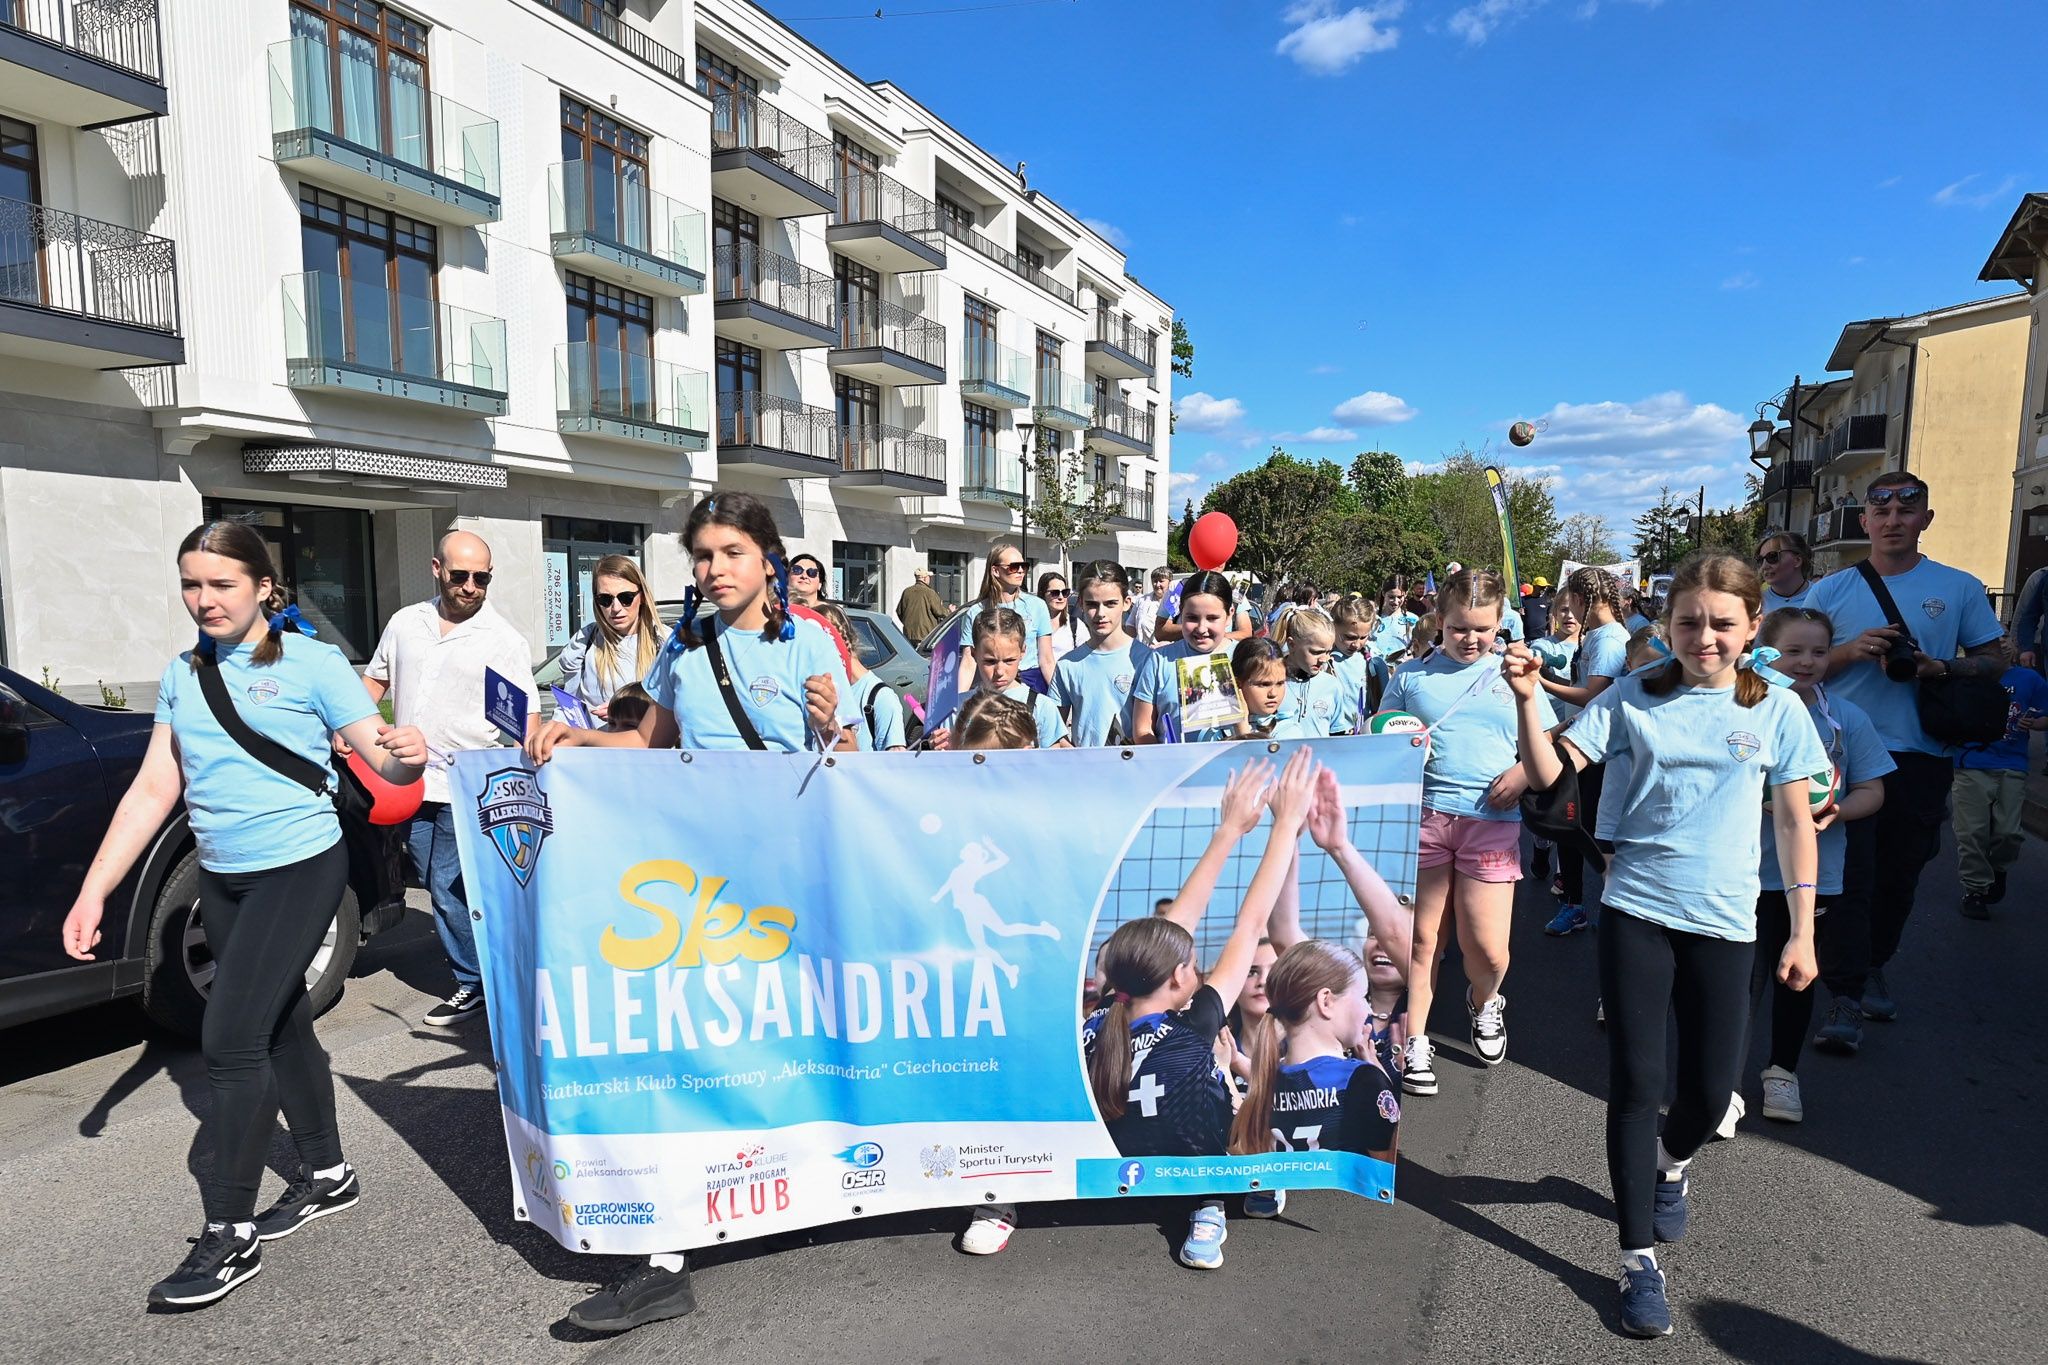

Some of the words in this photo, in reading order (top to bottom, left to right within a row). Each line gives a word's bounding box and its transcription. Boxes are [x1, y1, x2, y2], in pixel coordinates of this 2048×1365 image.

[547, 585, 553, 597] DO
[555, 612, 563, 632] 806
[502, 780, 526, 797] SKS
[535, 954, 1007, 1059] ALEKSANDRIA
[636, 1074, 676, 1093] Klub
[682, 1069, 767, 1093] Sportowy
[893, 1058, 1000, 1076] Ciechocinek
[1272, 1087, 1340, 1112] LEKSANDRIA
[959, 1144, 1005, 1156] Minister
[575, 1159, 607, 1168] Powiat
[705, 1161, 743, 1174] WITAJ
[754, 1152, 789, 1167] KLUBIE
[959, 1156, 996, 1169] Sportu
[1004, 1153, 1053, 1166] Turystyki
[1154, 1161, 1333, 1178] SKSALEKSANDRIAOFFICIAL
[576, 1164, 658, 1179] Aleksandrowski
[706, 1176, 745, 1191] RZĄDOWY
[749, 1168, 786, 1182] PROGRAM
[575, 1202, 655, 1215] UZDROWISKO
[576, 1213, 655, 1226] CIECHOCINEK
